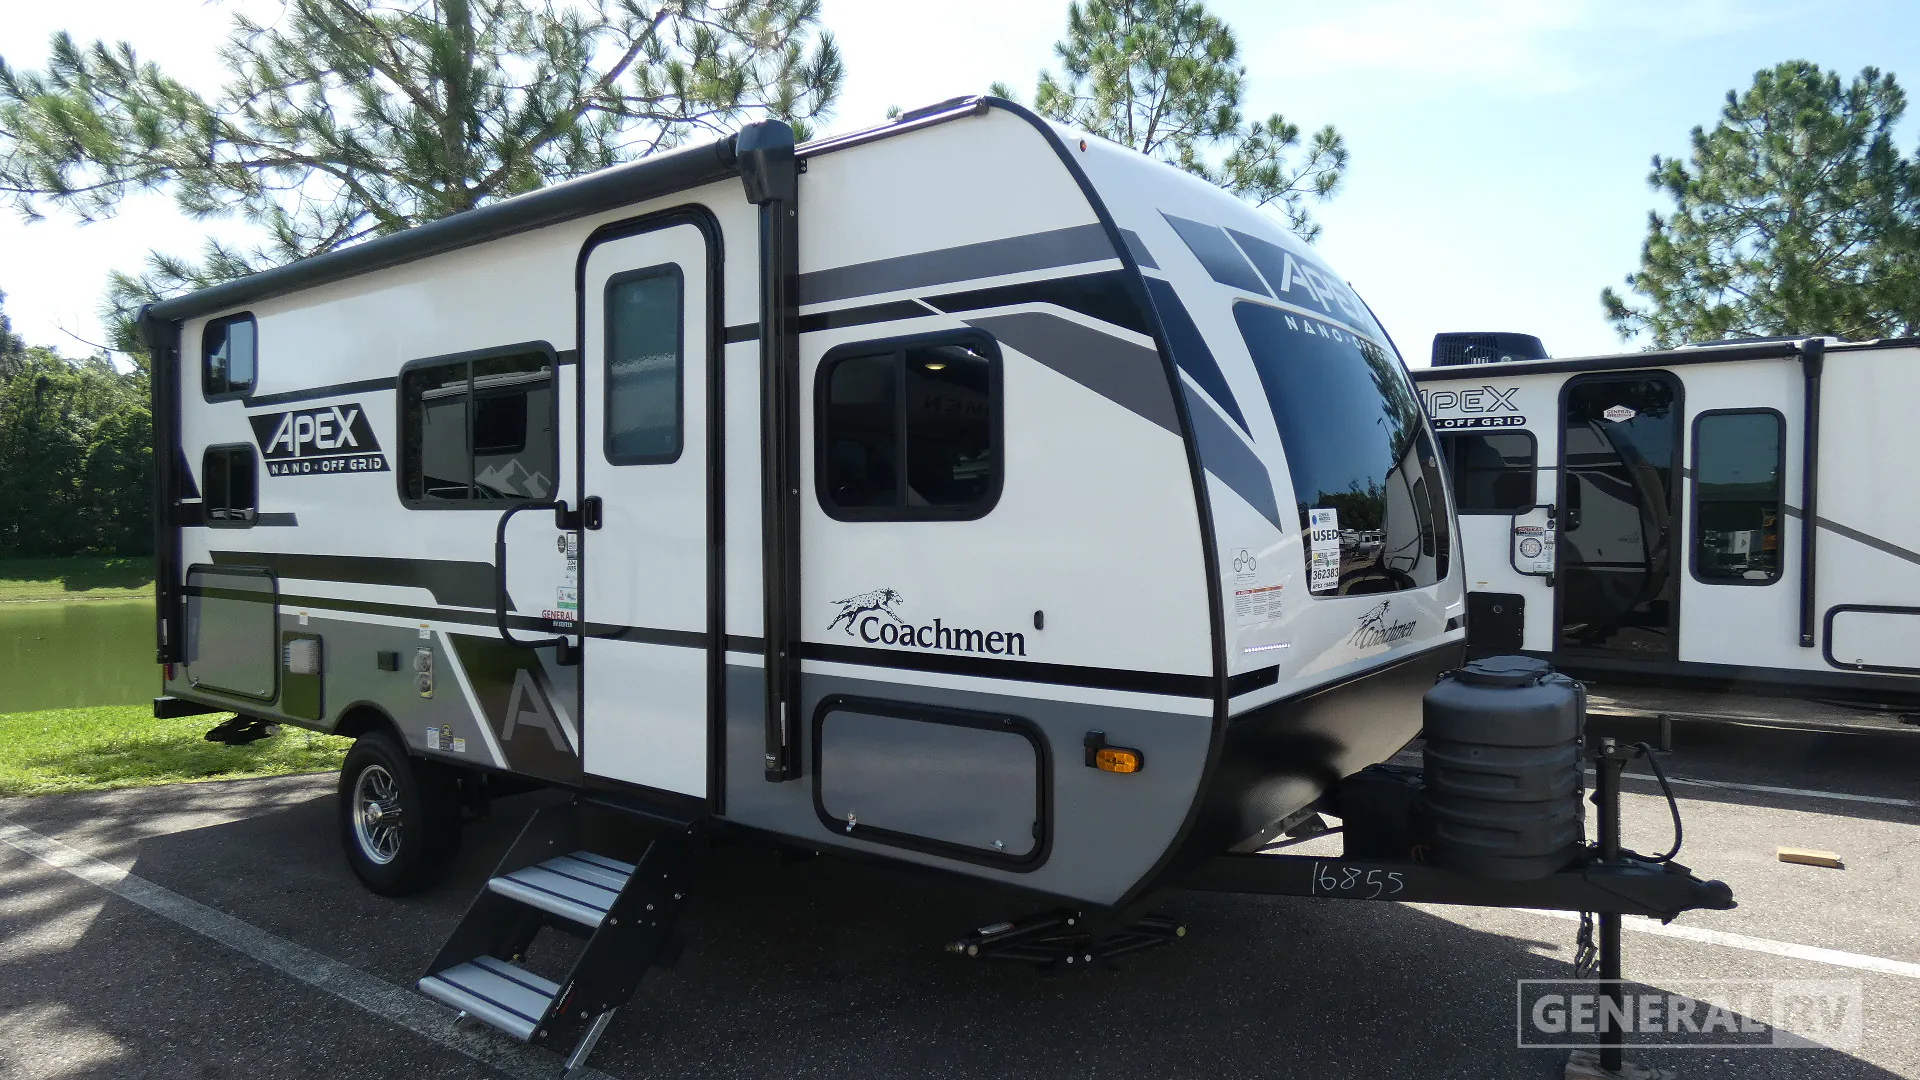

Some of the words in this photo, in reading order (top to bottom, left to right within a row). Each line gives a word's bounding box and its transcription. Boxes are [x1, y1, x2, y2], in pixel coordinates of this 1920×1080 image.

[1284, 315, 1343, 343] NANO
[266, 406, 359, 457] APEX
[1444, 419, 1476, 427] OFF
[1481, 417, 1524, 426] GRID
[272, 462, 311, 475] NANO
[322, 459, 345, 472] OFF
[350, 457, 382, 470] GRID
[1313, 529, 1339, 541] USED
[1313, 568, 1338, 580] 362383
[541, 609, 575, 621] GENERAL
[859, 616, 1027, 657] Coachmen
[1360, 619, 1417, 650] Coachmen
[1312, 861, 1404, 900] 16855
